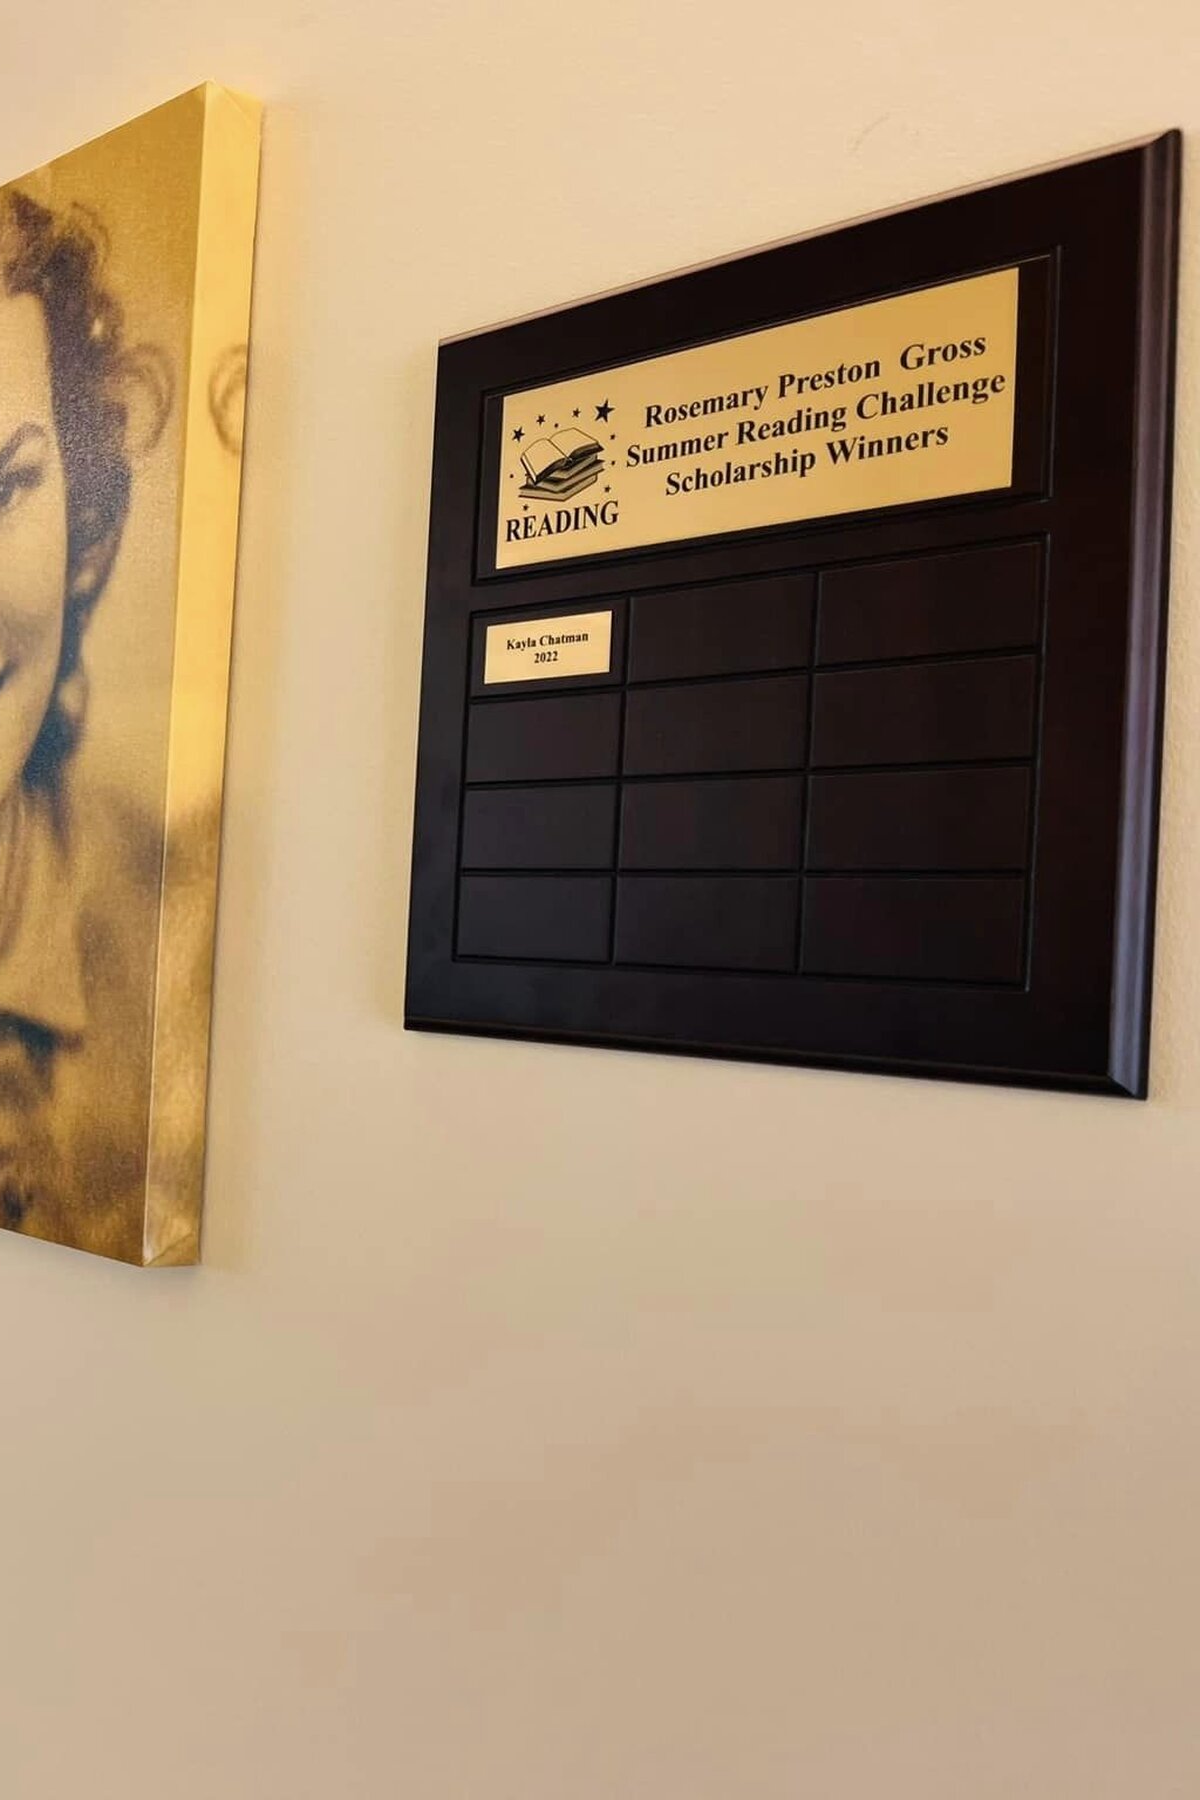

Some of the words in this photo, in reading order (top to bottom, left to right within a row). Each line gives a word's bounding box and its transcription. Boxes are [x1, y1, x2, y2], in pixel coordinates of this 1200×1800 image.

[645, 386, 769, 428] Rosemary
[778, 360, 880, 399] Preston
[900, 337, 986, 371] Gross
[627, 432, 730, 468] Summer
[737, 406, 847, 445] Reading
[856, 374, 1006, 420] Challenge
[665, 449, 816, 496] Scholarship
[826, 426, 949, 465] Winners
[506, 500, 619, 542] READING
[506, 638, 537, 652] Kayla
[539, 633, 589, 648] Chatman
[534, 651, 559, 664] 2022
